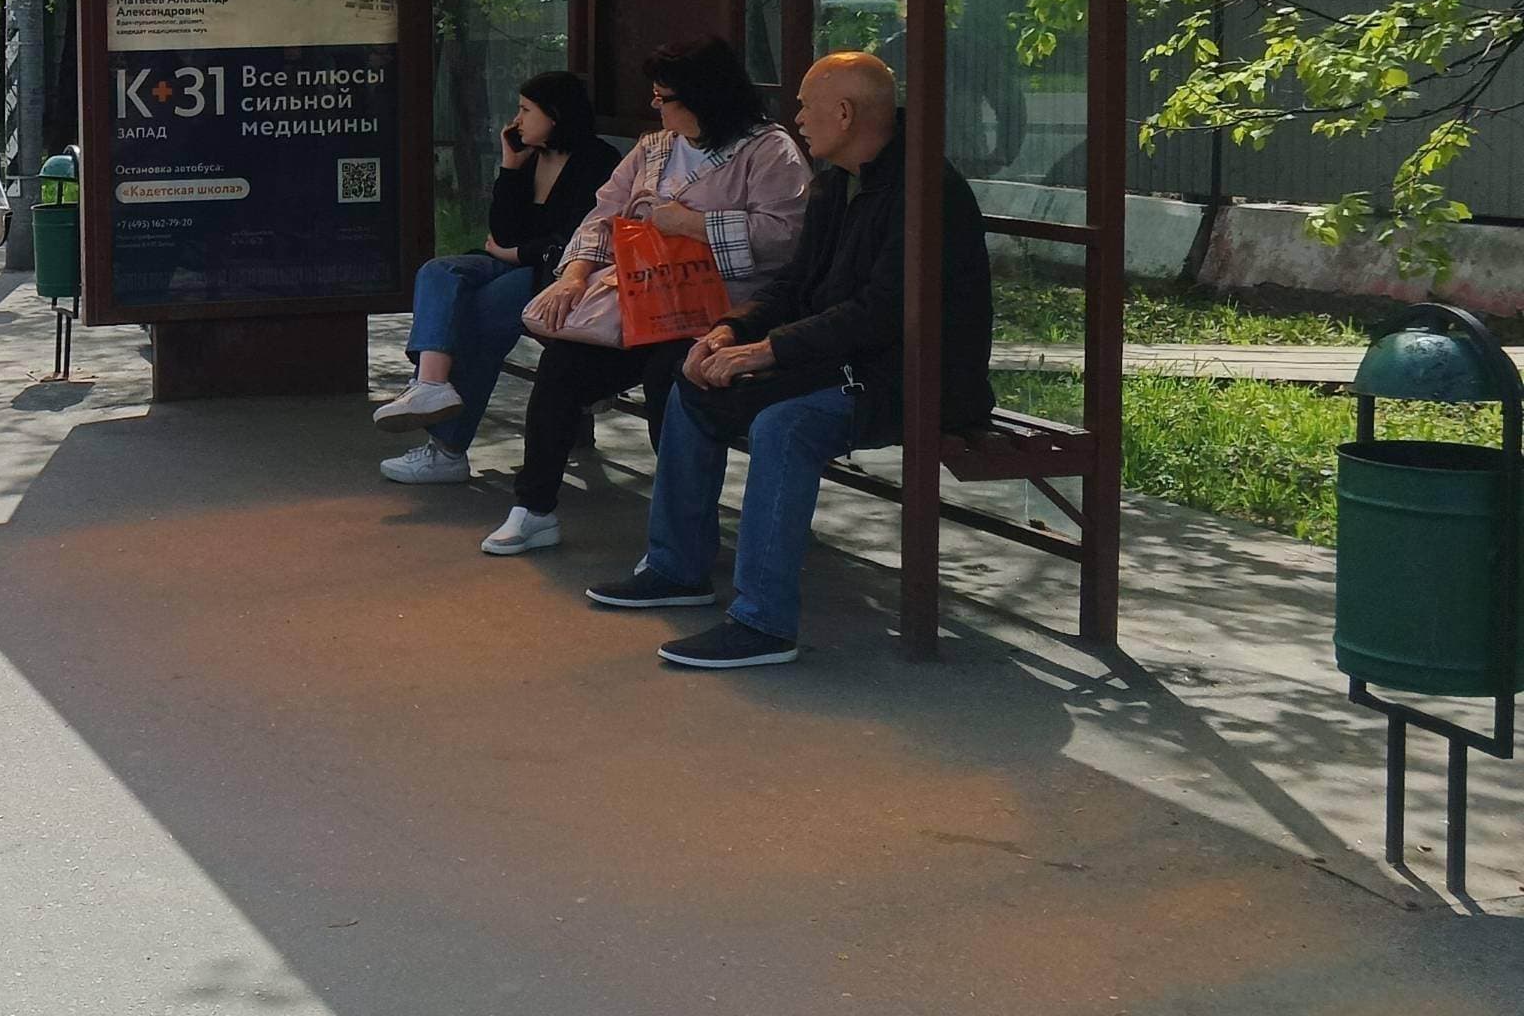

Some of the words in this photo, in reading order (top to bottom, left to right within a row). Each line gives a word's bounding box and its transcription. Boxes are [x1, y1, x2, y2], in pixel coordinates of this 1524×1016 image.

[116, 6, 205, 17] Александрович
[242, 65, 288, 88] Все
[297, 68, 385, 86] плюсы
[241, 87, 353, 112] сильной
[117, 126, 168, 140] ЗАПАД
[241, 117, 379, 138] медицины
[115, 164, 172, 175] Остановка
[174, 163, 224, 174] автобуса:
[123, 185, 194, 198] «Кадетская
[197, 184, 243, 195] школа»
[128, 219, 150, 230] (495)
